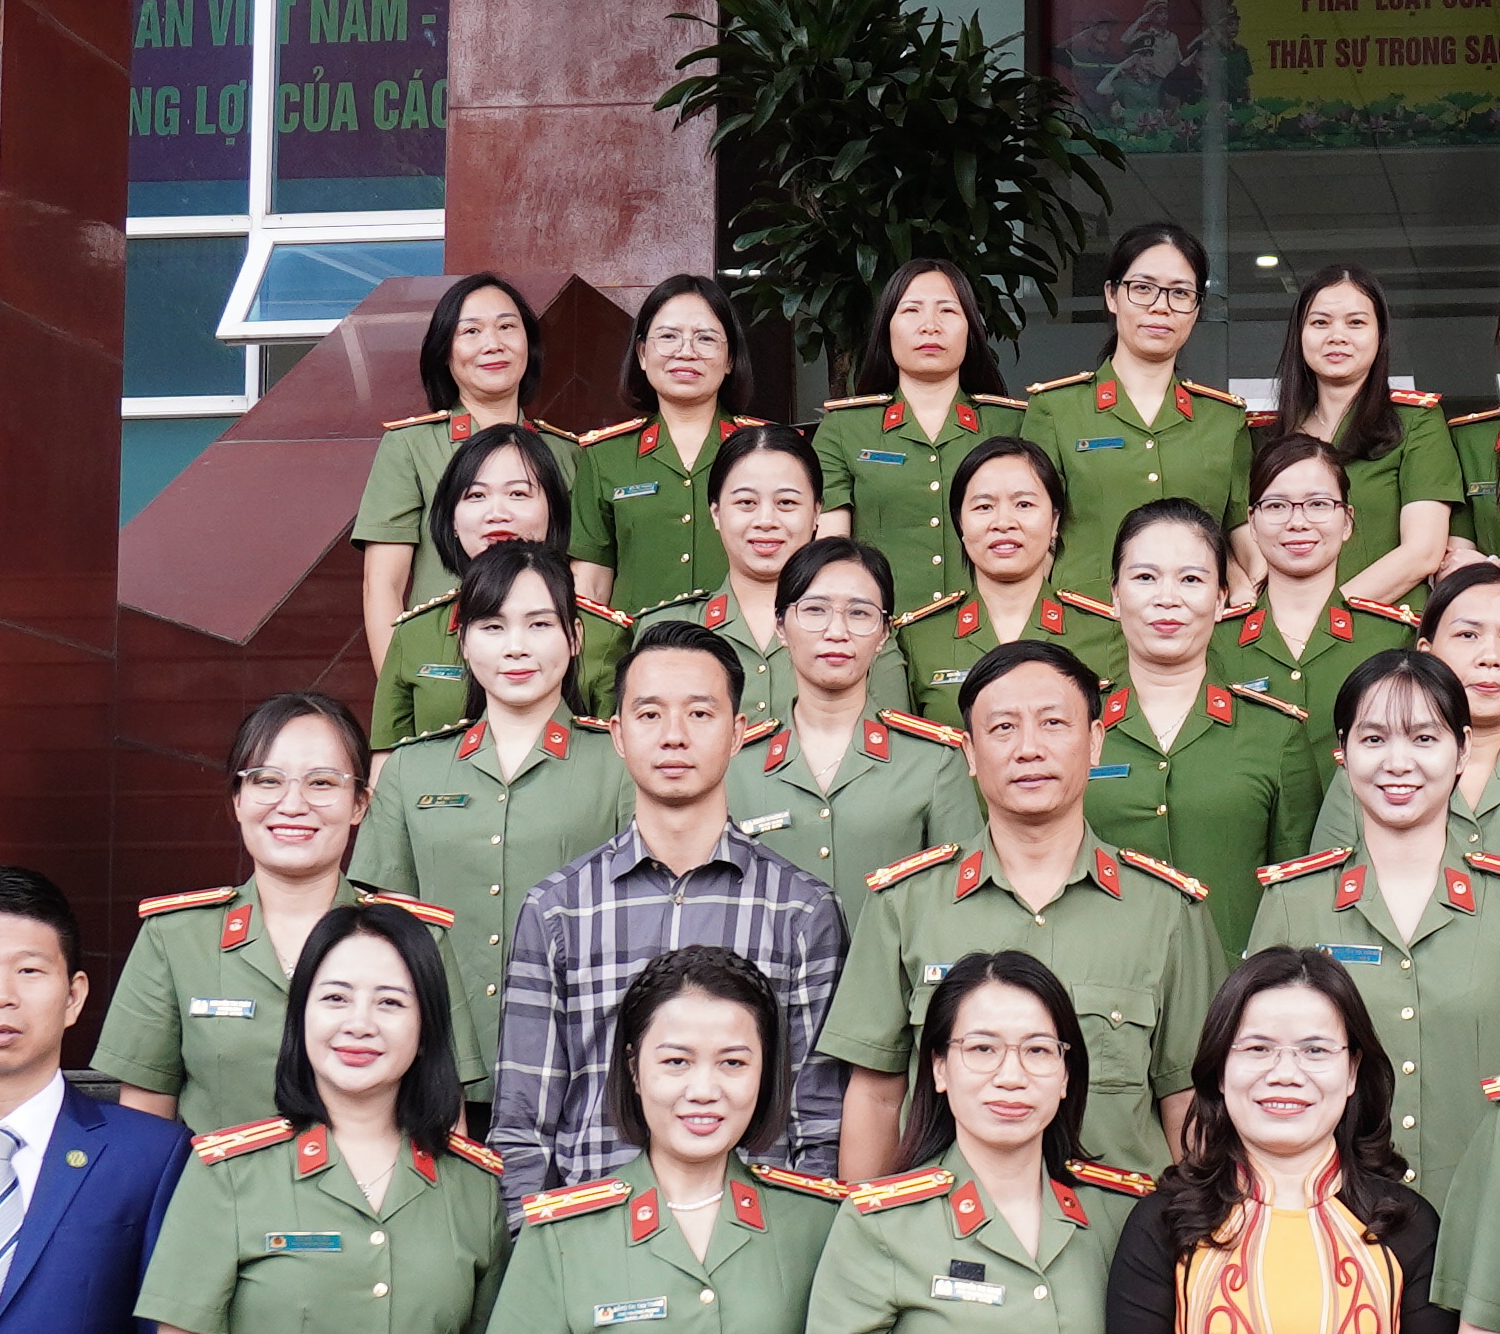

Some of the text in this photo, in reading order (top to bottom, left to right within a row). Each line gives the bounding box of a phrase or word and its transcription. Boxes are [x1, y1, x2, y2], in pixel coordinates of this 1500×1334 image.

[1268, 34, 1327, 74] THẬT
[1334, 35, 1371, 73] SỰ
[1376, 35, 1456, 66] TRONG
[278, 65, 358, 133] CỦA
